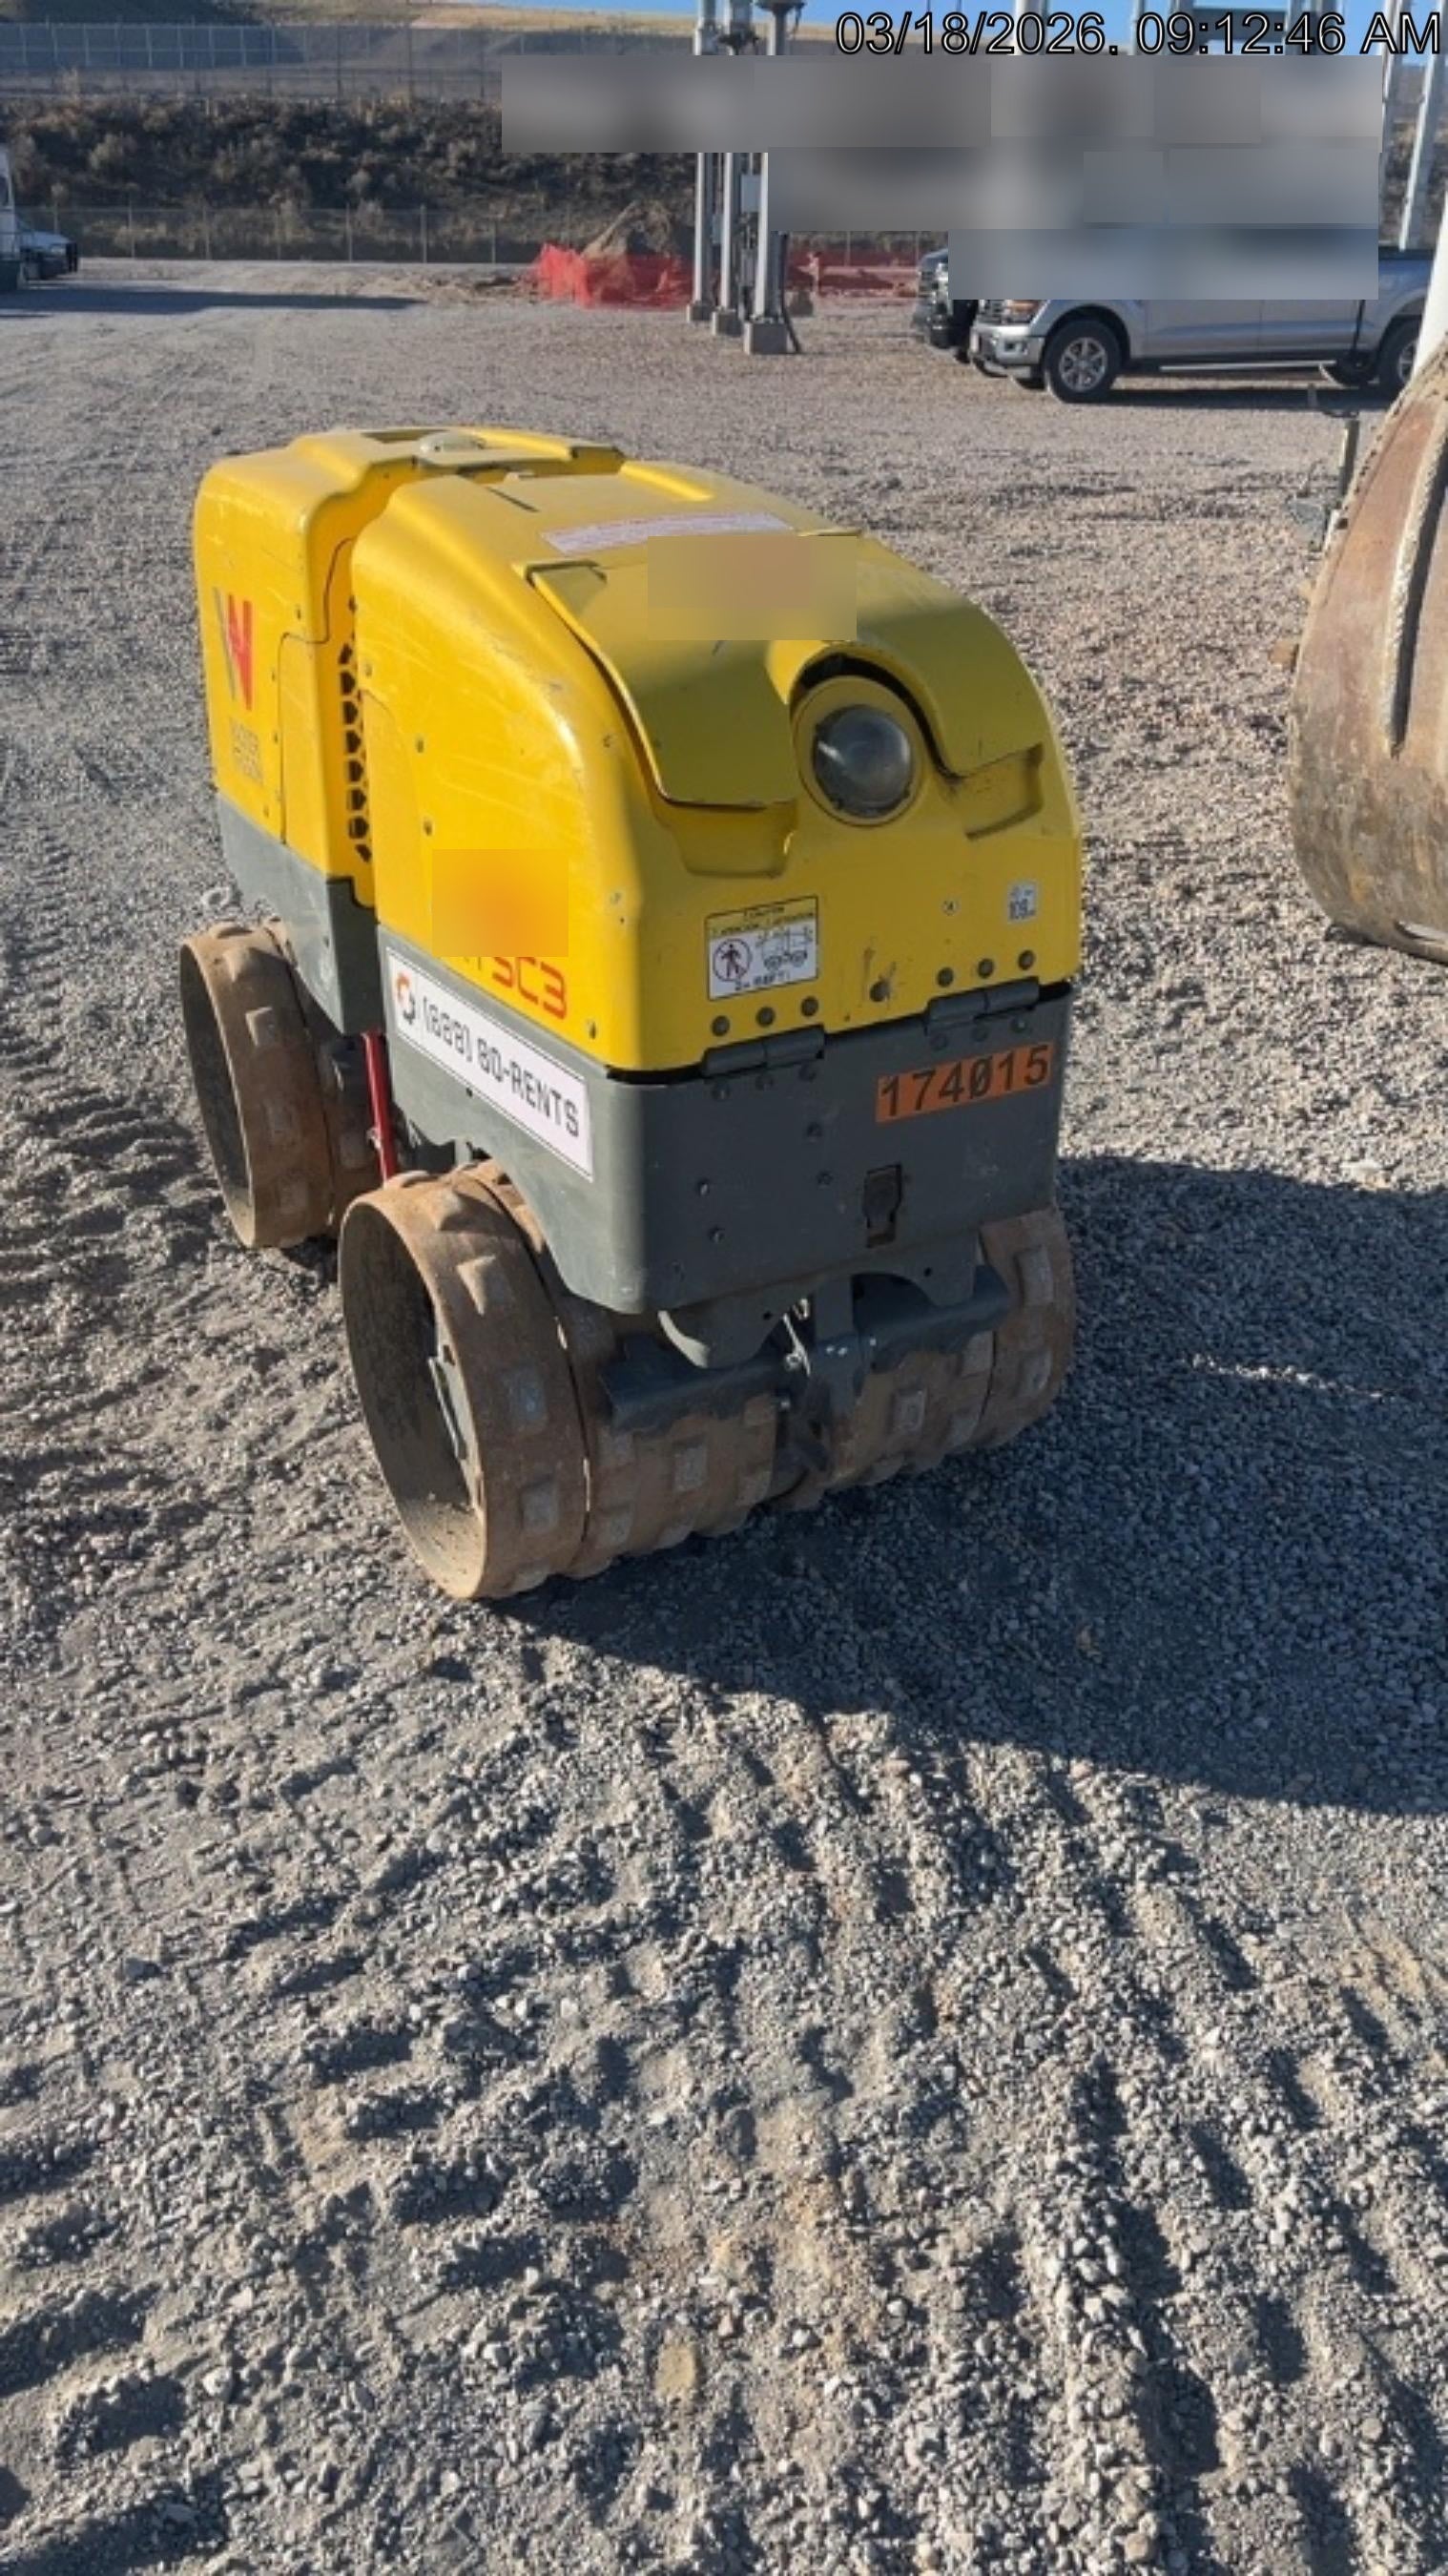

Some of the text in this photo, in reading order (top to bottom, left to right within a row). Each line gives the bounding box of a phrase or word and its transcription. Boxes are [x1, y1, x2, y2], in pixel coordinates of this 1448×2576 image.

[422, 995, 580, 1137] (888) 80-RENTS
[881, 1045, 1048, 1116] 174015
